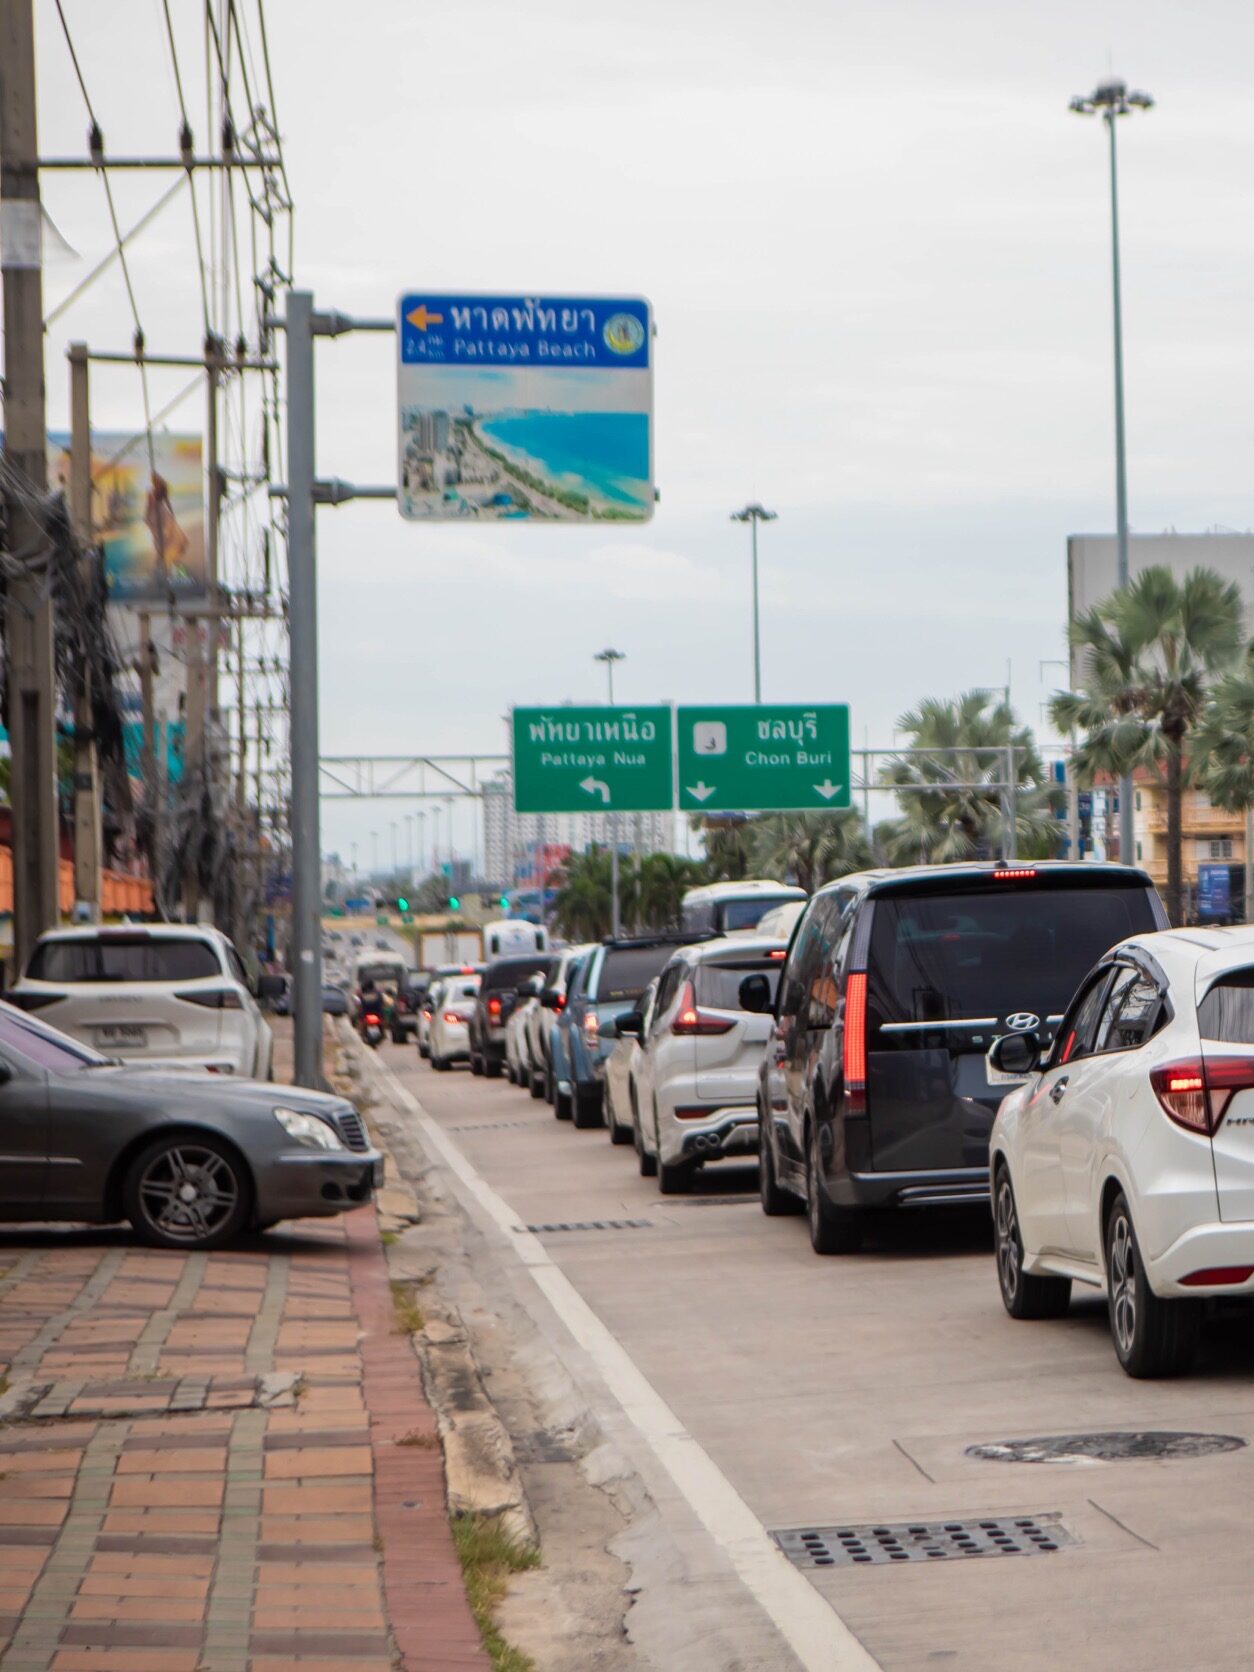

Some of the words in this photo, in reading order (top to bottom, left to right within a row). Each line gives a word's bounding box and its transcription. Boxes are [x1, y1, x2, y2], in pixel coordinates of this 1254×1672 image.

[450, 296, 597, 333] หาดพัทยา
[454, 338, 530, 359] Pattaya
[538, 339, 597, 358] Beach
[528, 712, 656, 743] พัทยาเหนือ
[757, 711, 818, 746] ชลบุรี
[541, 752, 606, 768] Pattaya
[613, 750, 647, 765] Nua
[745, 751, 790, 766] Chon
[796, 750, 833, 765] Buri
